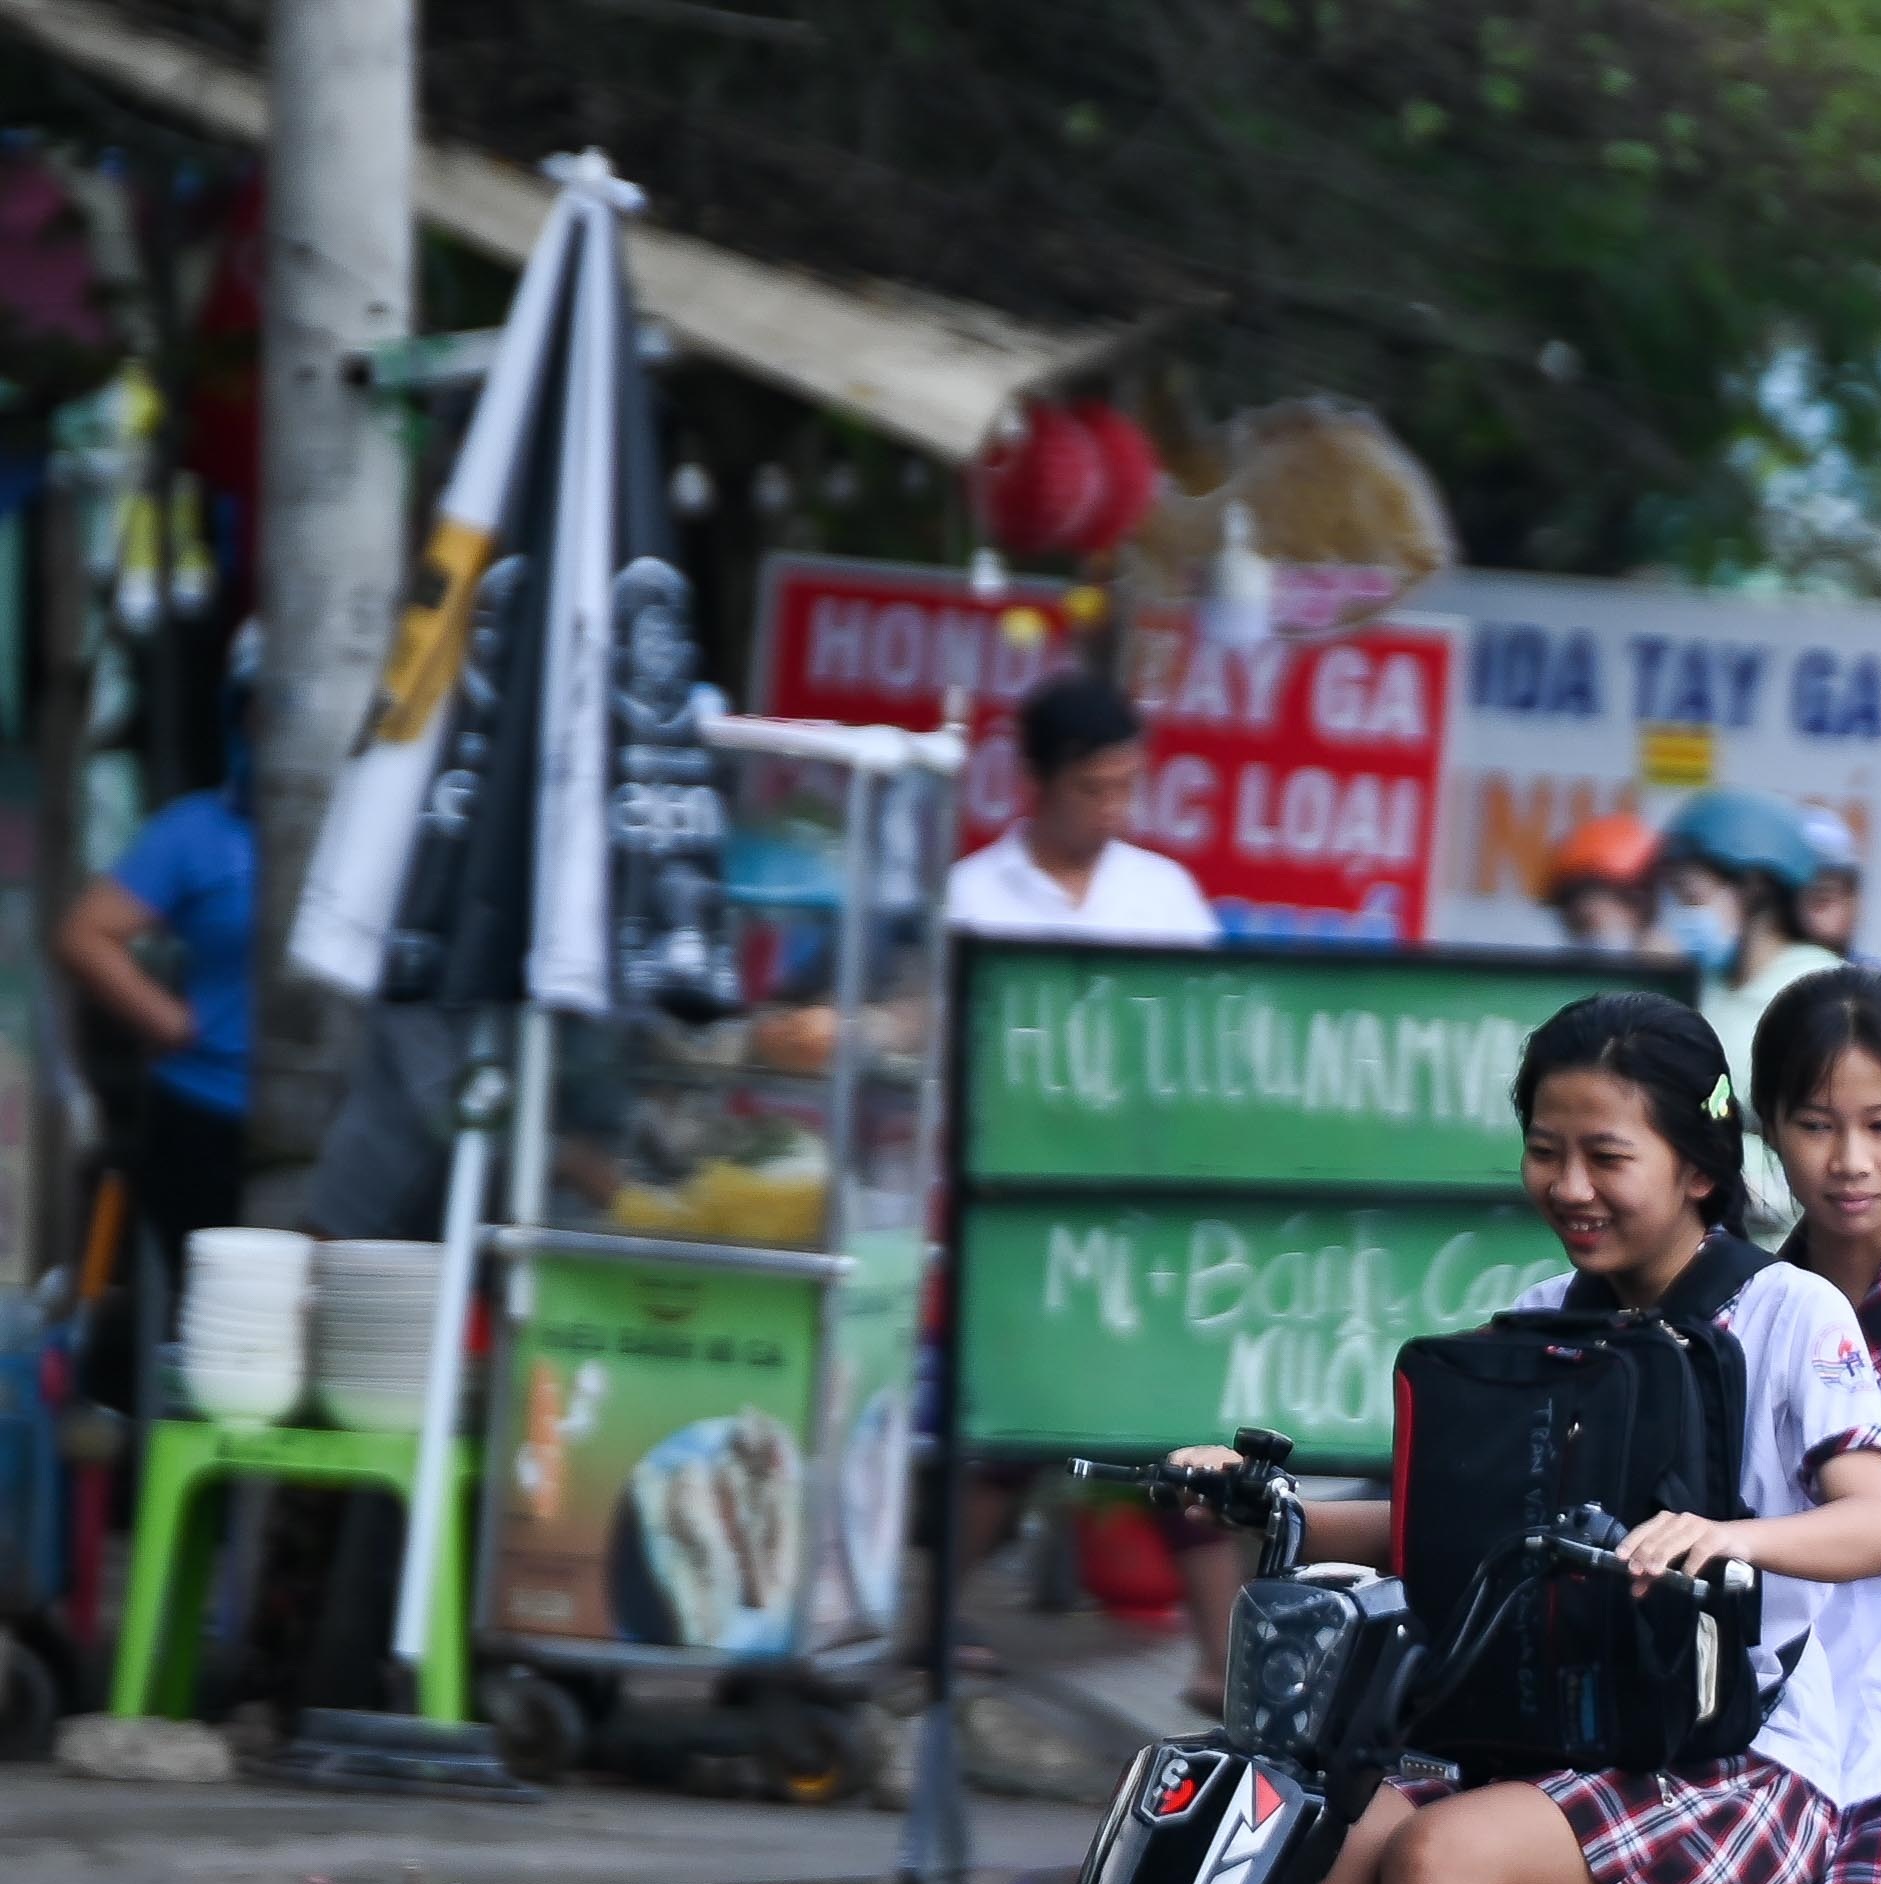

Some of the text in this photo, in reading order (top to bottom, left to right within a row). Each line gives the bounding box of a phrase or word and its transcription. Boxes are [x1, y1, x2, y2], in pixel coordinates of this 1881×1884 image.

[1308, 642, 1428, 740] GA
[1627, 632, 1766, 730] TAY
[1232, 757, 1420, 880] LOẠI
